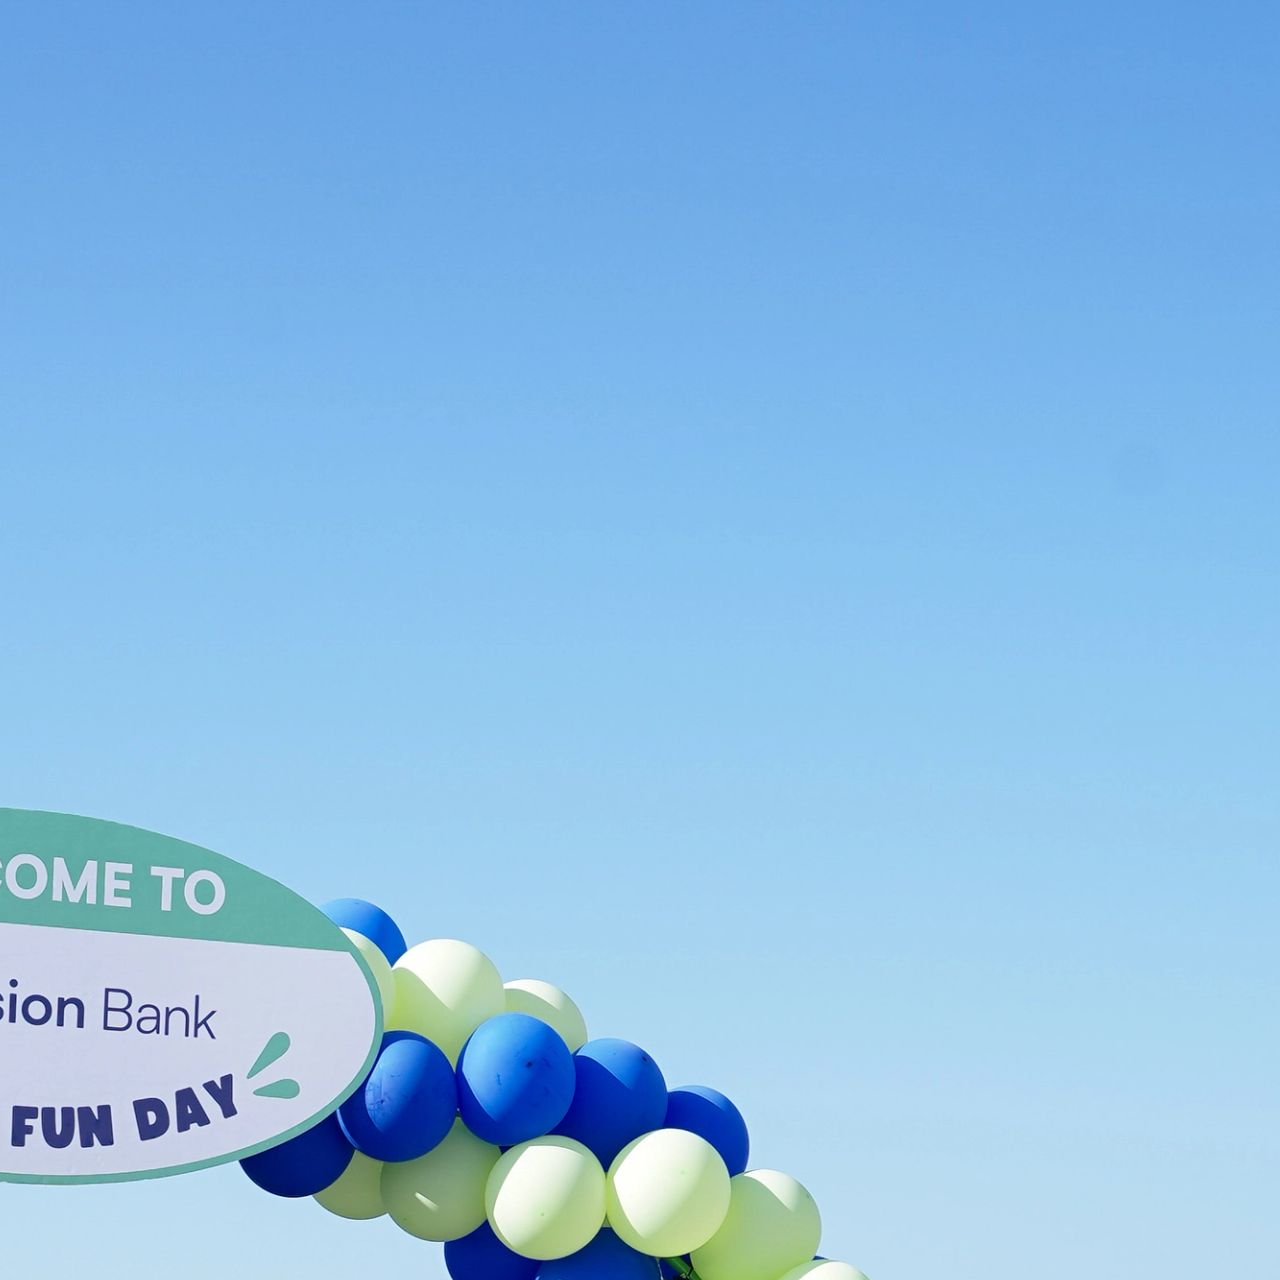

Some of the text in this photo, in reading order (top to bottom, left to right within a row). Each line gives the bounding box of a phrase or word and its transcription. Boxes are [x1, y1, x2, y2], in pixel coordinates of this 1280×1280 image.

[150, 865, 226, 916] TO
[102, 987, 217, 1040] Bank
[10, 1104, 115, 1149] FUN
[132, 1073, 238, 1142] DAY
